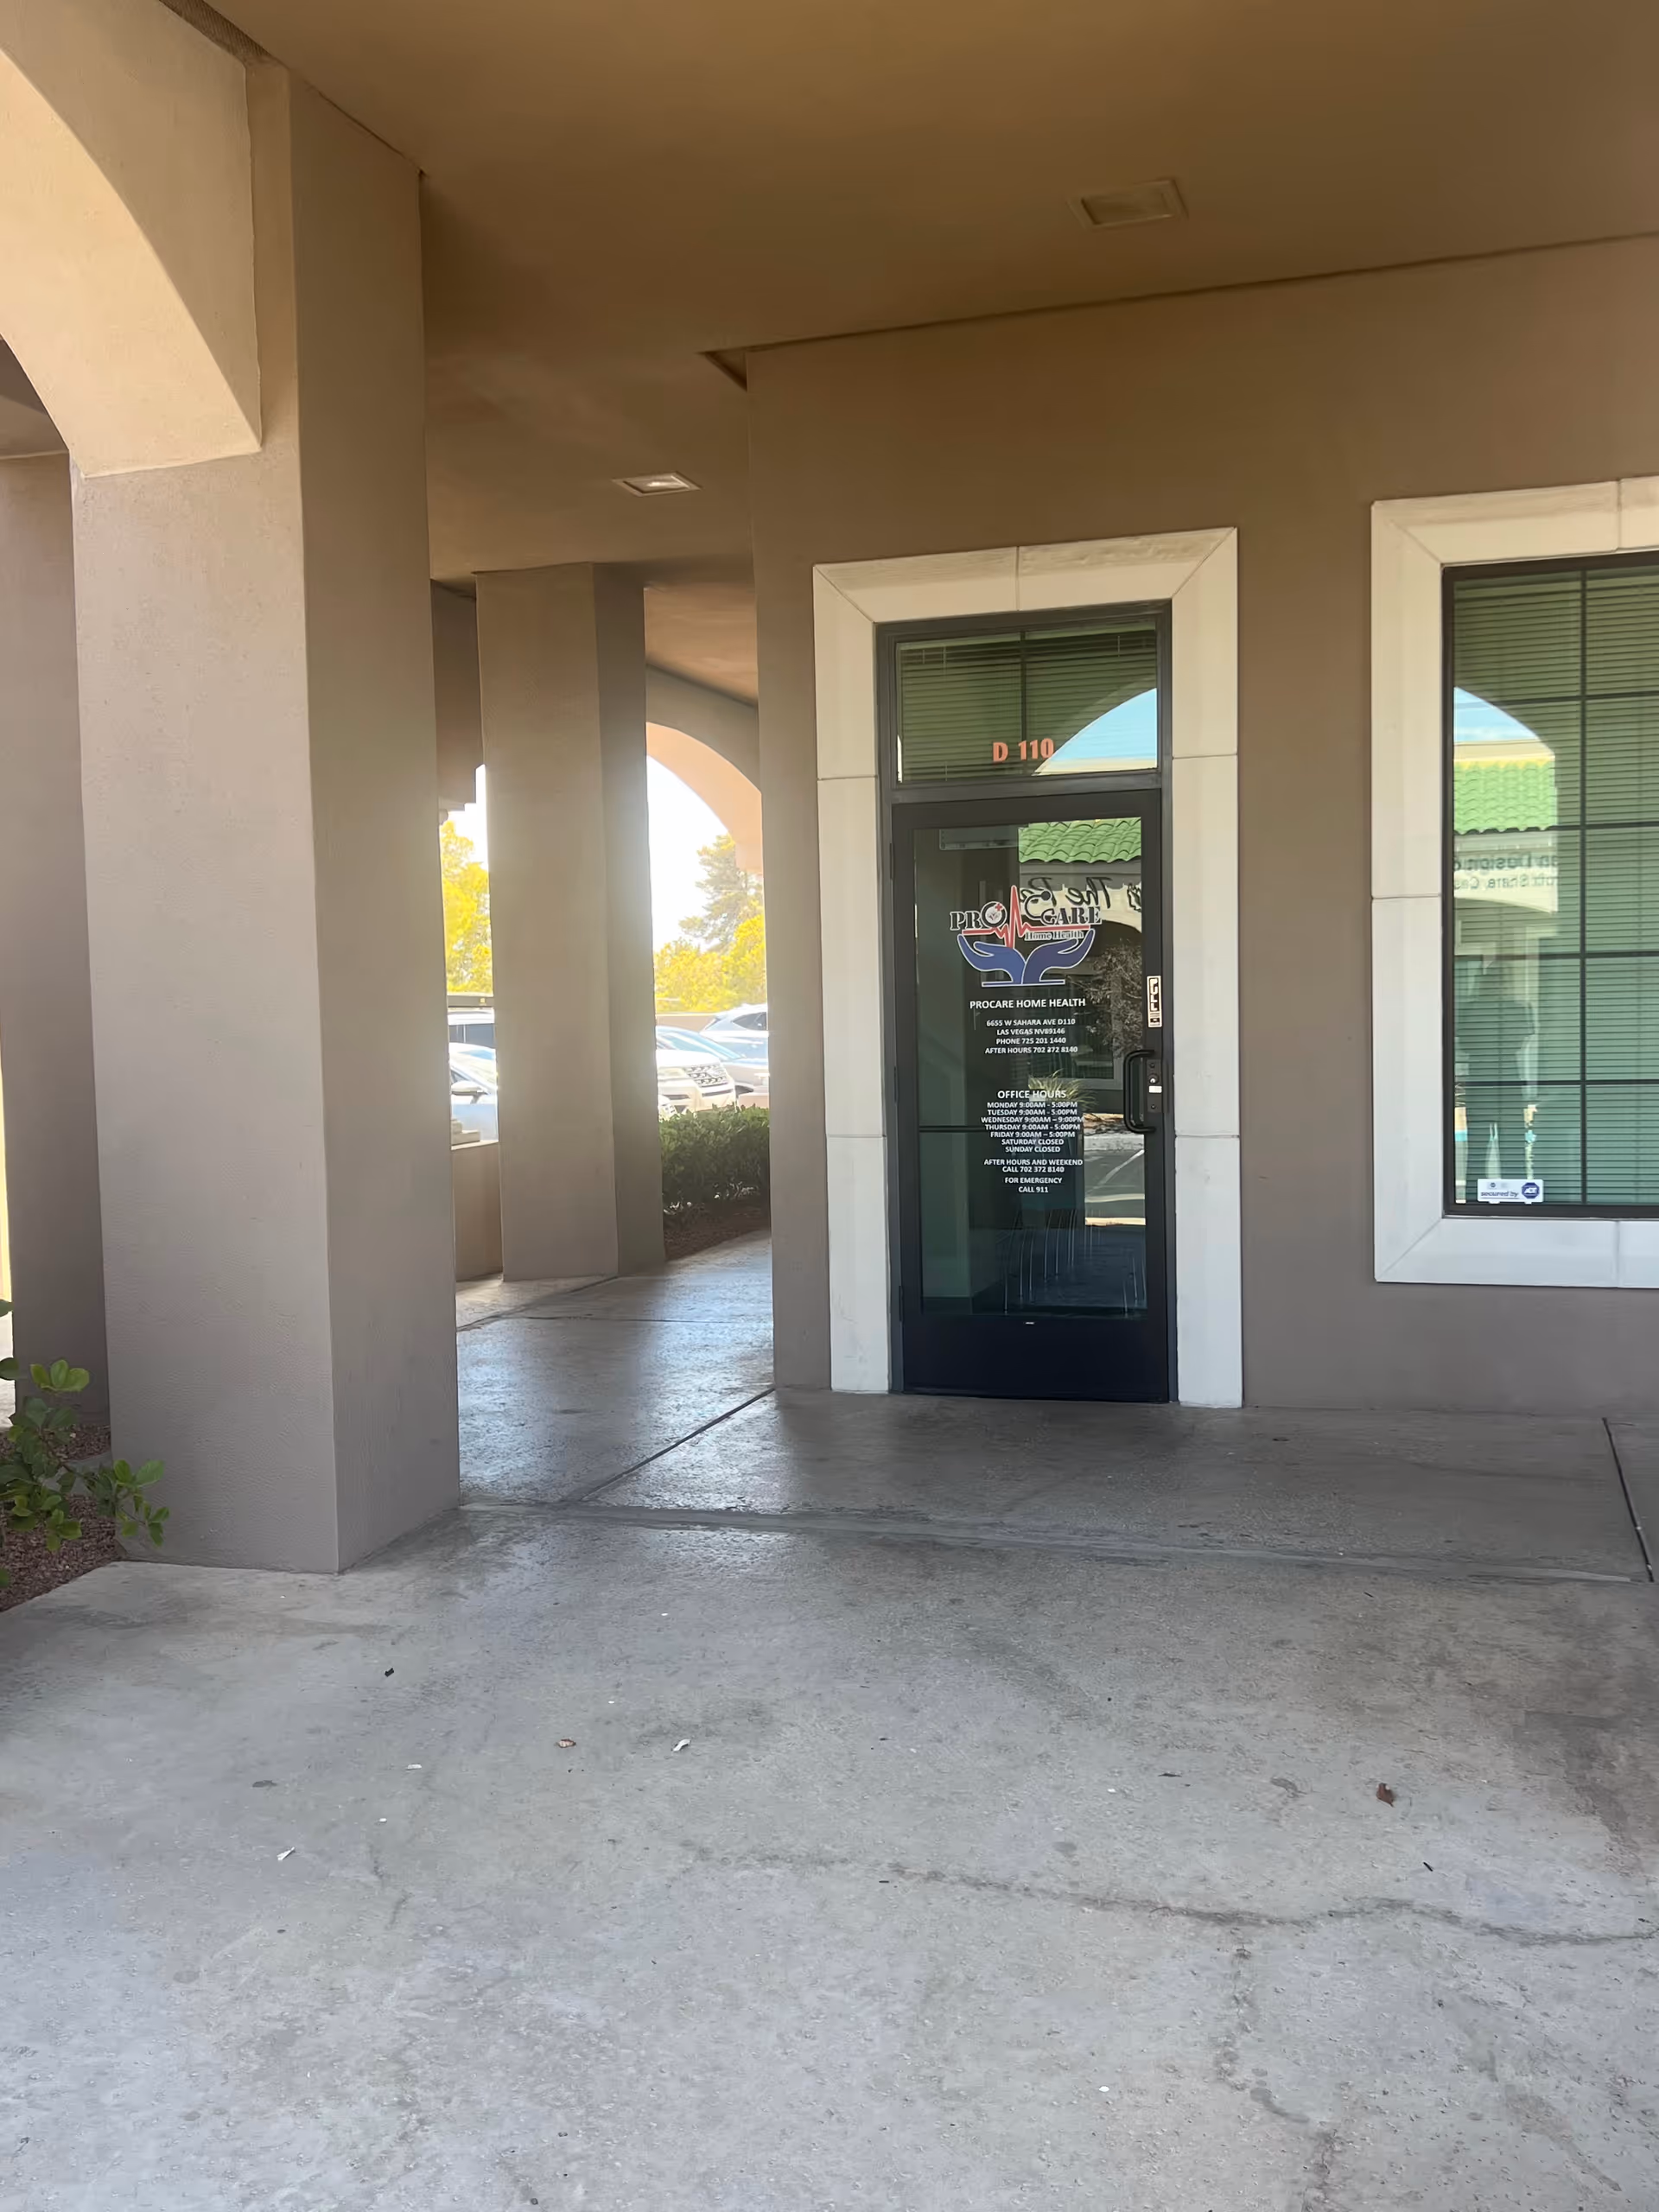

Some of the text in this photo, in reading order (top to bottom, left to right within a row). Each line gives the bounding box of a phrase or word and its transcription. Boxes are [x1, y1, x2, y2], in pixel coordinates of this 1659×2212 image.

[993, 738, 1054, 762] D 110
[950, 901, 1102, 931] PRO CARE
[1026, 930, 1084, 941] Home Health
[969, 998, 1086, 1009] PROCARE HOME HEALTH
[997, 1090, 1066, 1099] OFFICE HOURS
